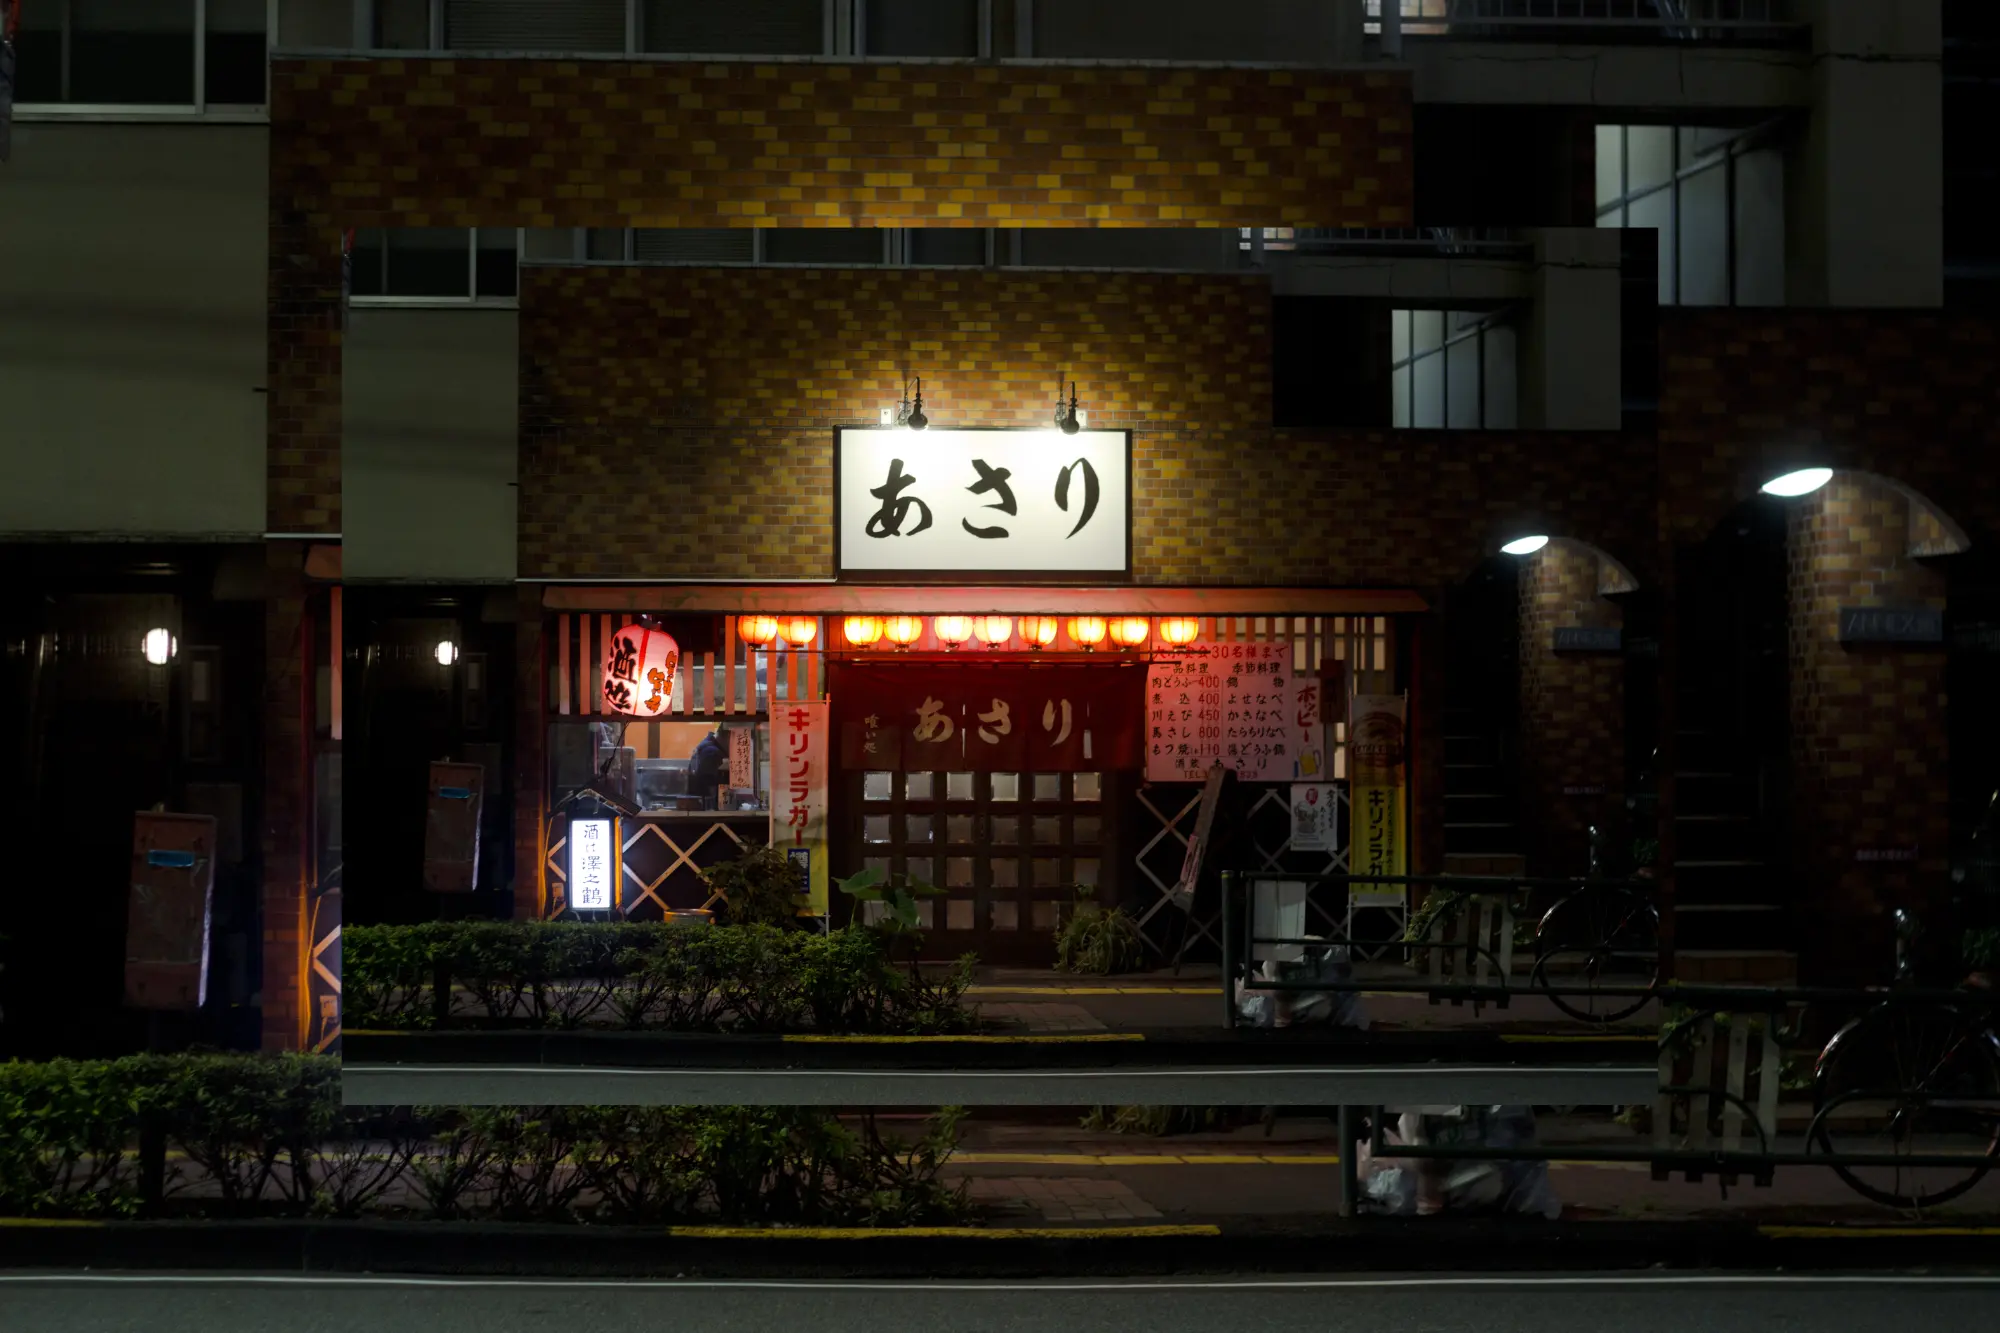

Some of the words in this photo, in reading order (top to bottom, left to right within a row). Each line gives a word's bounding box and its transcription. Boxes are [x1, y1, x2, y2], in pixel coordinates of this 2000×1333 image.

[865, 457, 1100, 539] あさり
[1160, 662, 1209, 675] 一品料理
[1232, 662, 1281, 675] 季節料理
[1199, 676, 1220, 689] 400
[1199, 693, 1220, 705] 400
[1228, 693, 1284, 706] よせなべ
[913, 695, 1073, 747] あさり
[1152, 709, 1193, 722] 川えび
[1199, 709, 1220, 722] 450
[1228, 709, 1284, 722] かきなべ
[1297, 686, 1318, 743] ホッピー
[1199, 726, 1220, 739] 800
[1227, 726, 1286, 739] たらちりなべ
[788, 709, 810, 845] キリンラガー
[581, 824, 603, 905] 酒は澤之鶴
